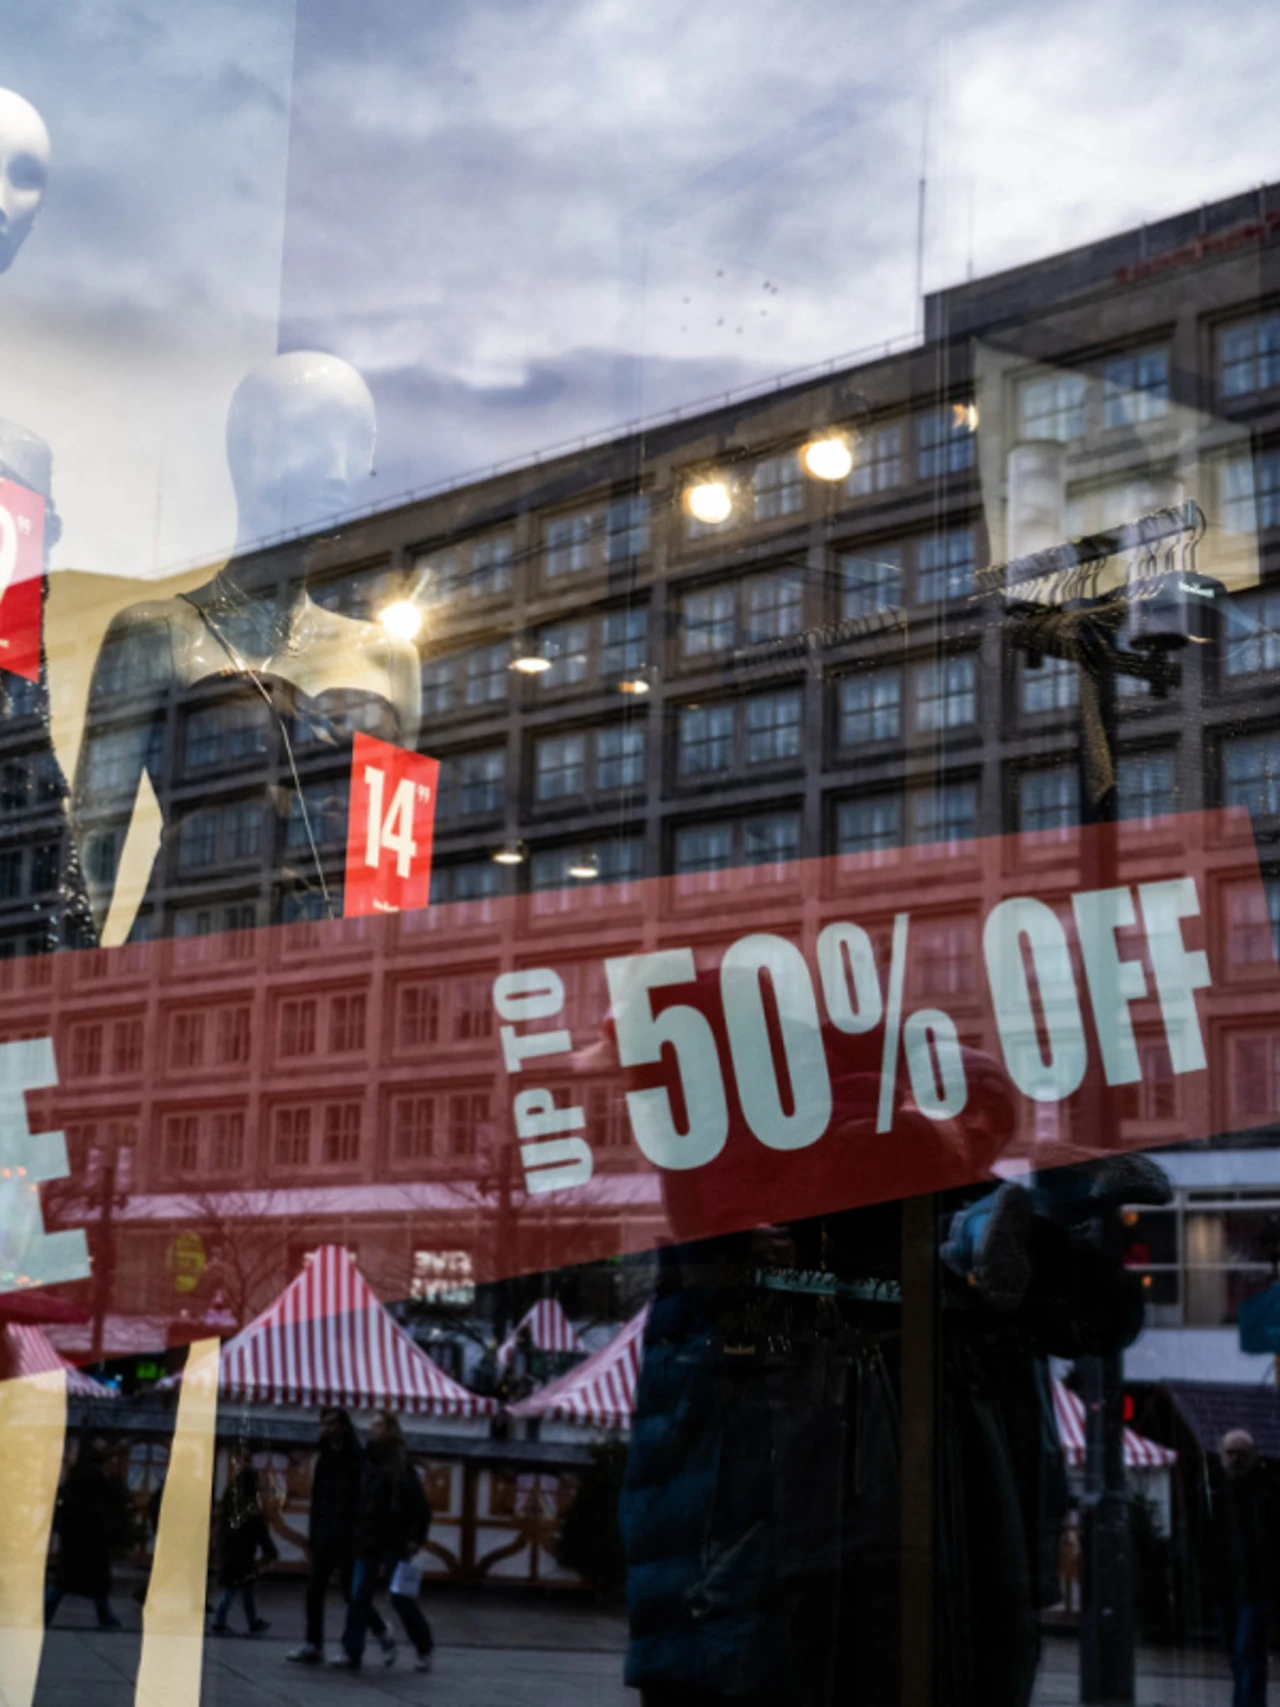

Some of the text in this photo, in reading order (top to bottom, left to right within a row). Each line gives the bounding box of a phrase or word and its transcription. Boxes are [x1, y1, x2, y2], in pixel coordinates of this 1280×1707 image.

[364, 764, 416, 880] 14
[492, 967, 593, 1194] UP TO
[605, 877, 1213, 1170] 50% OFF
